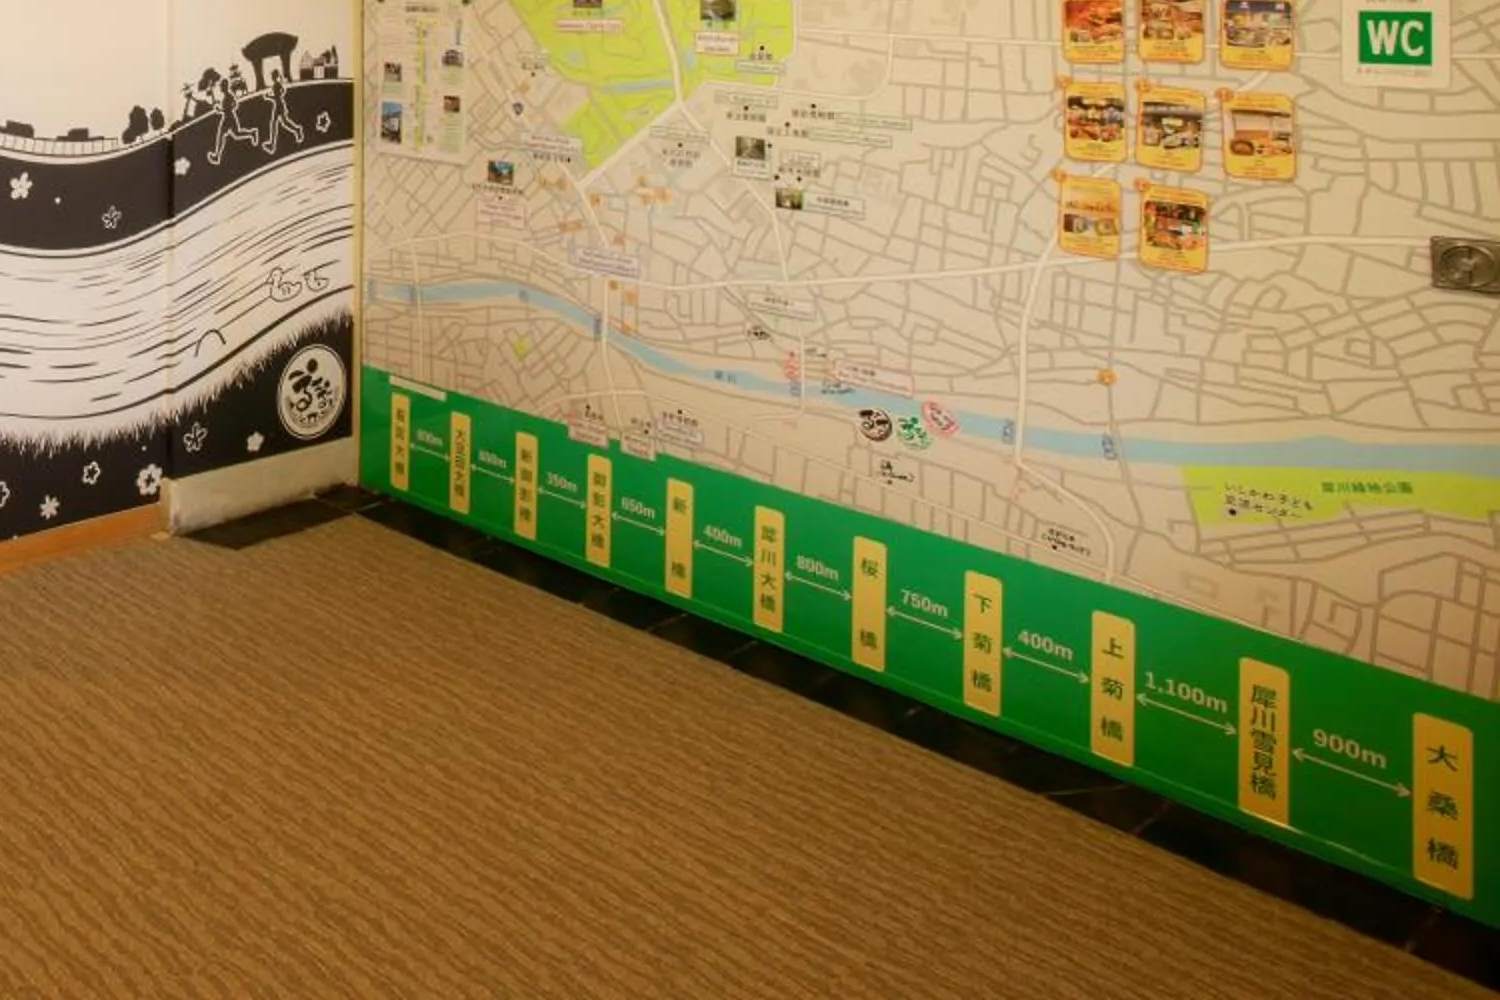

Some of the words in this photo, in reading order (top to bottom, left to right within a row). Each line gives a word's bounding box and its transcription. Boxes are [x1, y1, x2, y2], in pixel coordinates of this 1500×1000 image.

[1366, 20, 1425, 57] WC
[703, 523, 743, 549] 400m
[796, 554, 839, 581] 800m
[901, 588, 949, 617] 750m
[972, 594, 993, 692] 下菊橋
[1017, 629, 1074, 661] 400m
[1100, 637, 1125, 741] 上菊橋
[1249, 683, 1278, 801] 犀川雪見橋
[1312, 728, 1388, 769] 900m
